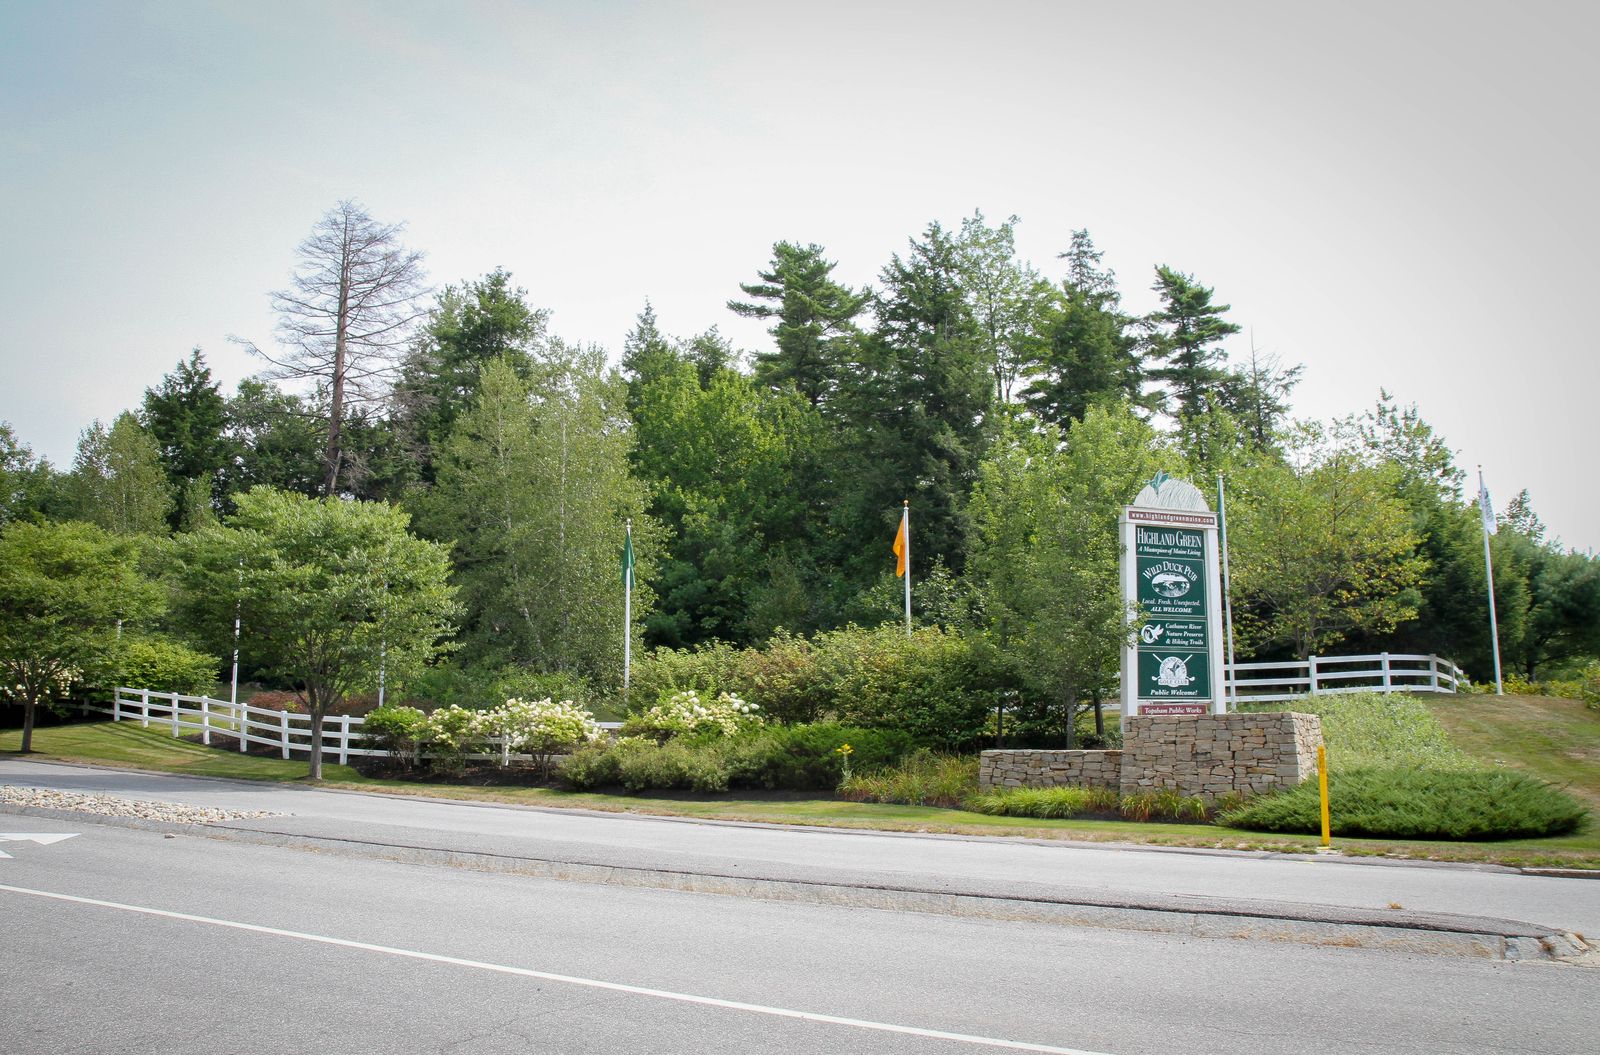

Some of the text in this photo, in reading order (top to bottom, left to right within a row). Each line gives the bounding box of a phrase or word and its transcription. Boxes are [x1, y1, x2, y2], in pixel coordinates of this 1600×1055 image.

[1131, 512, 1214, 524] www.highlandgreenmaine.com
[1137, 528, 1202, 548] HIGHLAND GREEN
[1143, 546, 1168, 554] Masterpiece
[1187, 548, 1202, 556] Living
[1142, 561, 1198, 582] WILD DUCK PUB
